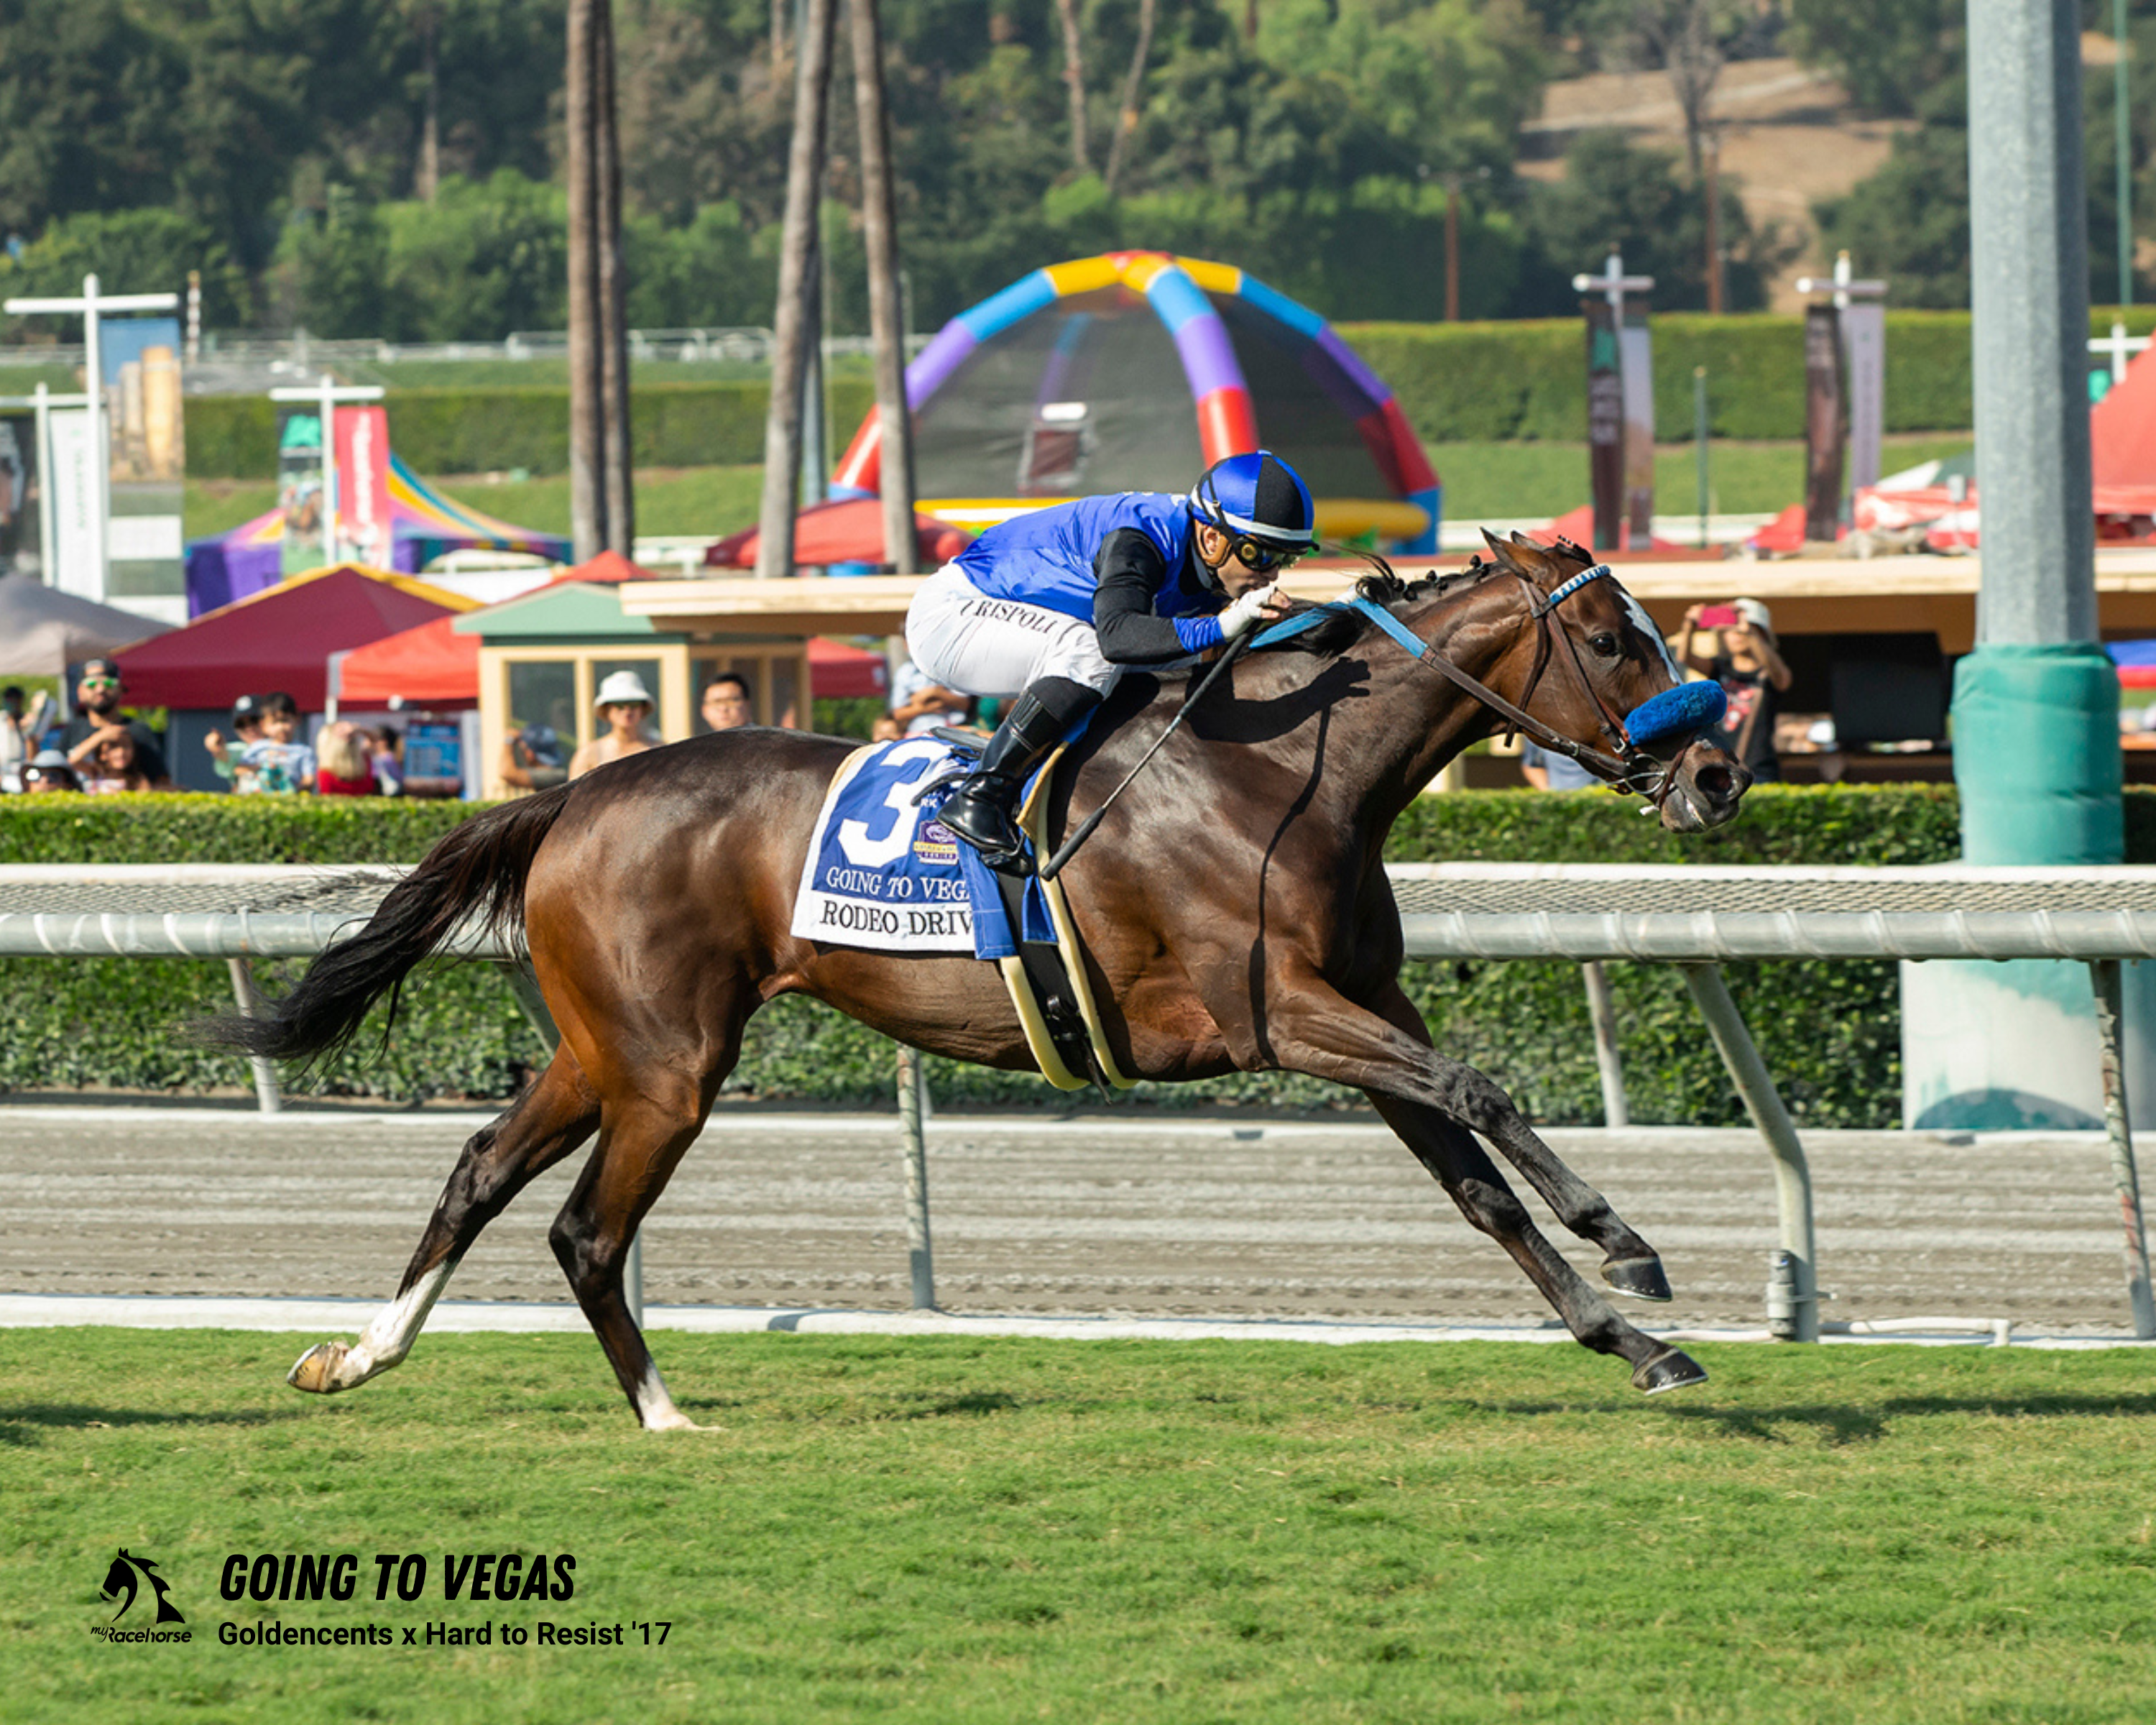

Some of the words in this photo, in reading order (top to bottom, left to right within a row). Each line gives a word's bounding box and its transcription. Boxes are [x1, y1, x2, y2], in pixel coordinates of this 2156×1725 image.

[973, 599, 1058, 634] RISPOLI
[837, 740, 953, 868] 3
[826, 866, 882, 896] GOING
[886, 876, 913, 898] TO
[919, 876, 970, 901] VEG
[819, 900, 899, 934] RODEO
